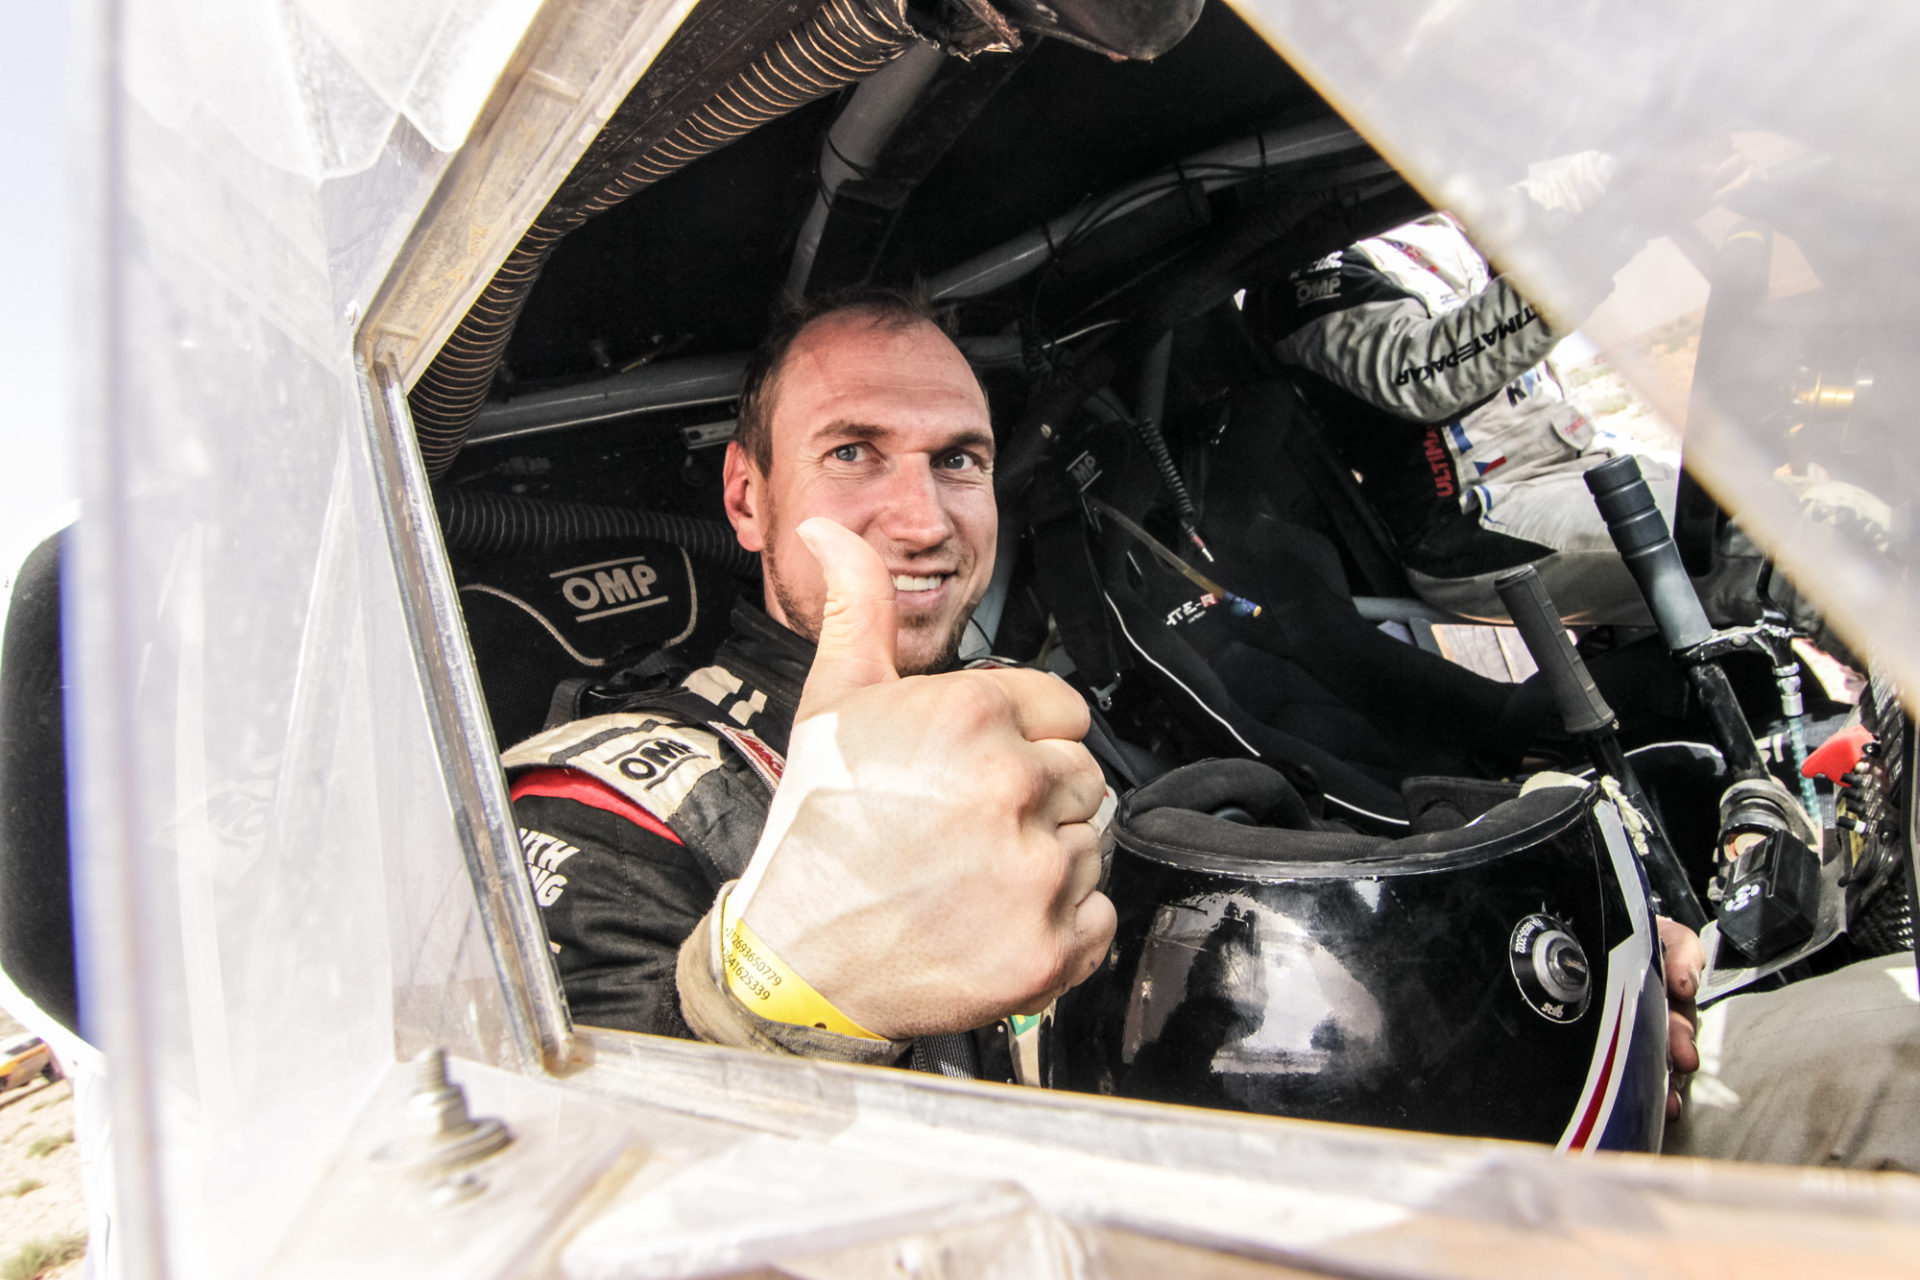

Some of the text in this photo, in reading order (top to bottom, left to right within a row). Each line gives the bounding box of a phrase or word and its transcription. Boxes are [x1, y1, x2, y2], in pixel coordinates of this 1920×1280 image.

[1296, 276, 1341, 301] OMP
[1071, 455, 1097, 485] MP
[562, 564, 657, 610] OMP
